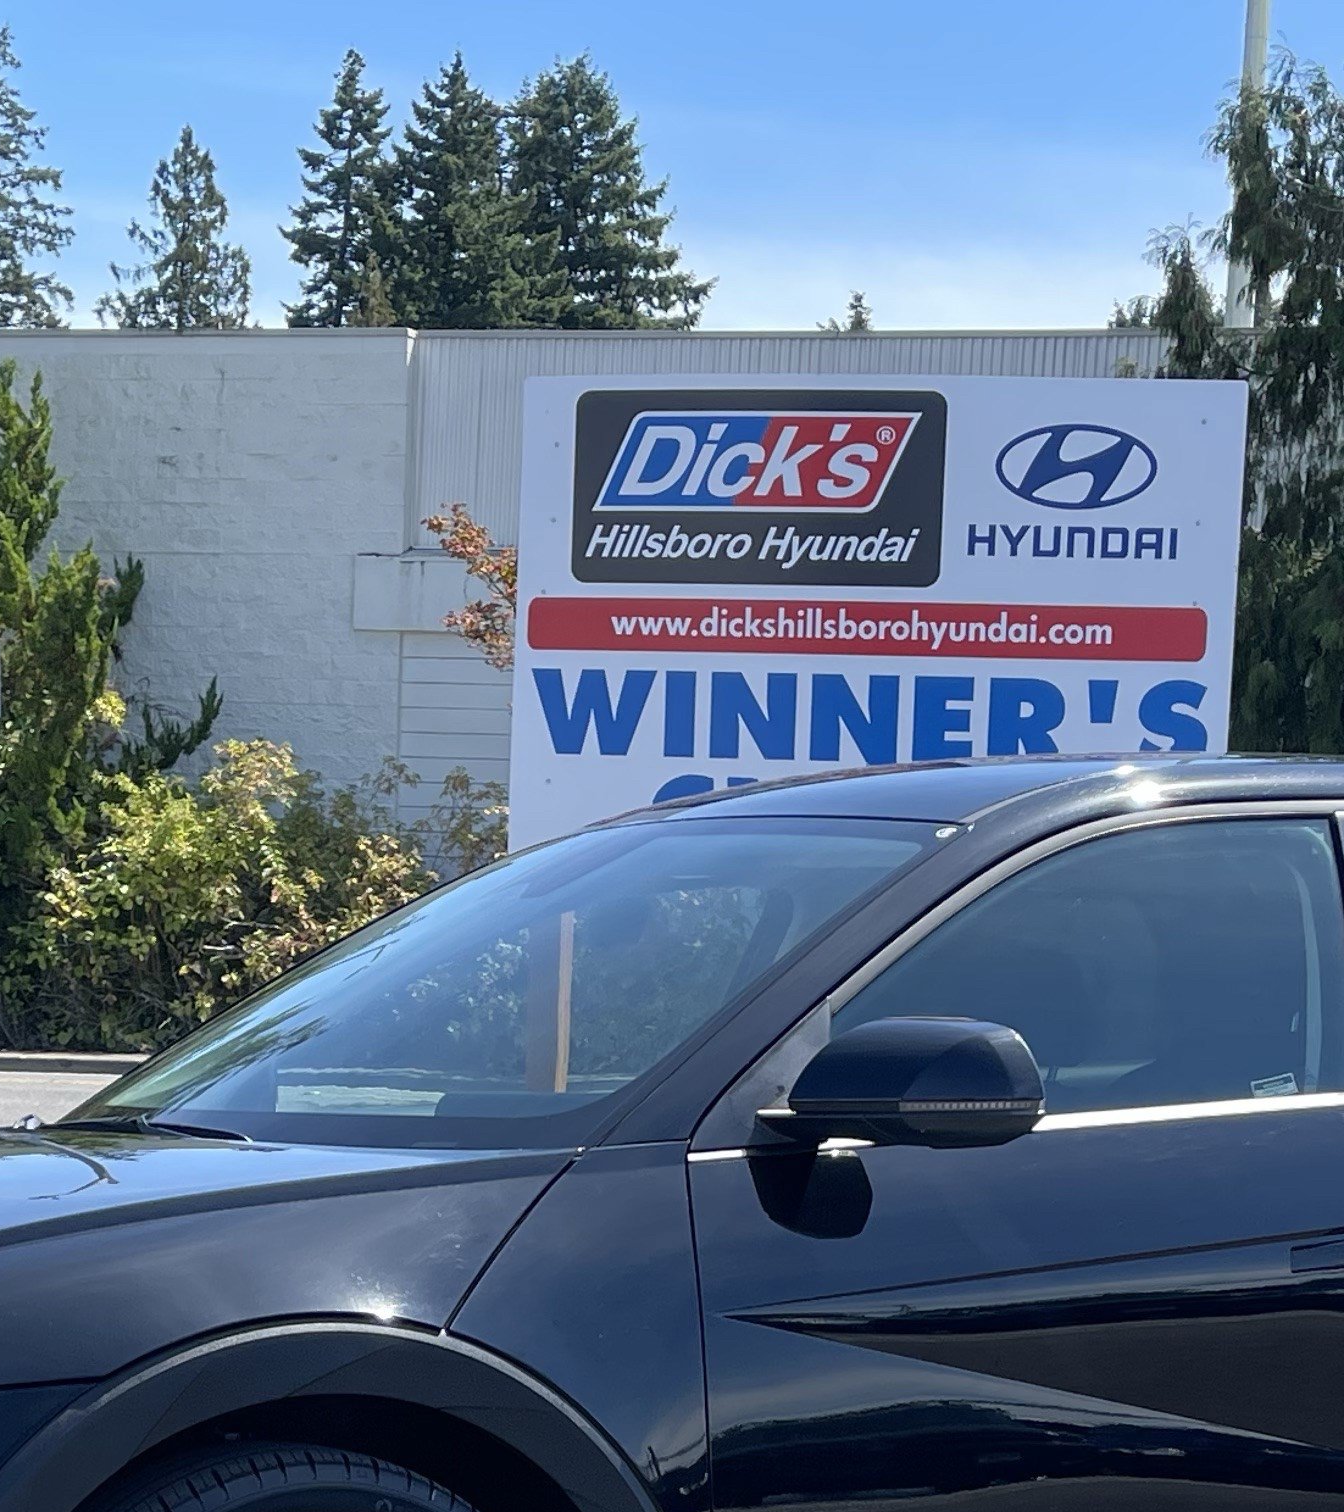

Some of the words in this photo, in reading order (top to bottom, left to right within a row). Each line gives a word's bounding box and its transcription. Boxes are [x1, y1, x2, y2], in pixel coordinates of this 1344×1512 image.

[617, 422, 879, 498] Dick's
[585, 524, 752, 559] Hillsboro
[758, 526, 920, 569] Hyundai
[967, 524, 1178, 560] HYUNDAI
[611, 607, 1113, 649] www.dickshillsborohyundai.com
[532, 668, 1208, 766] WINNER'S
